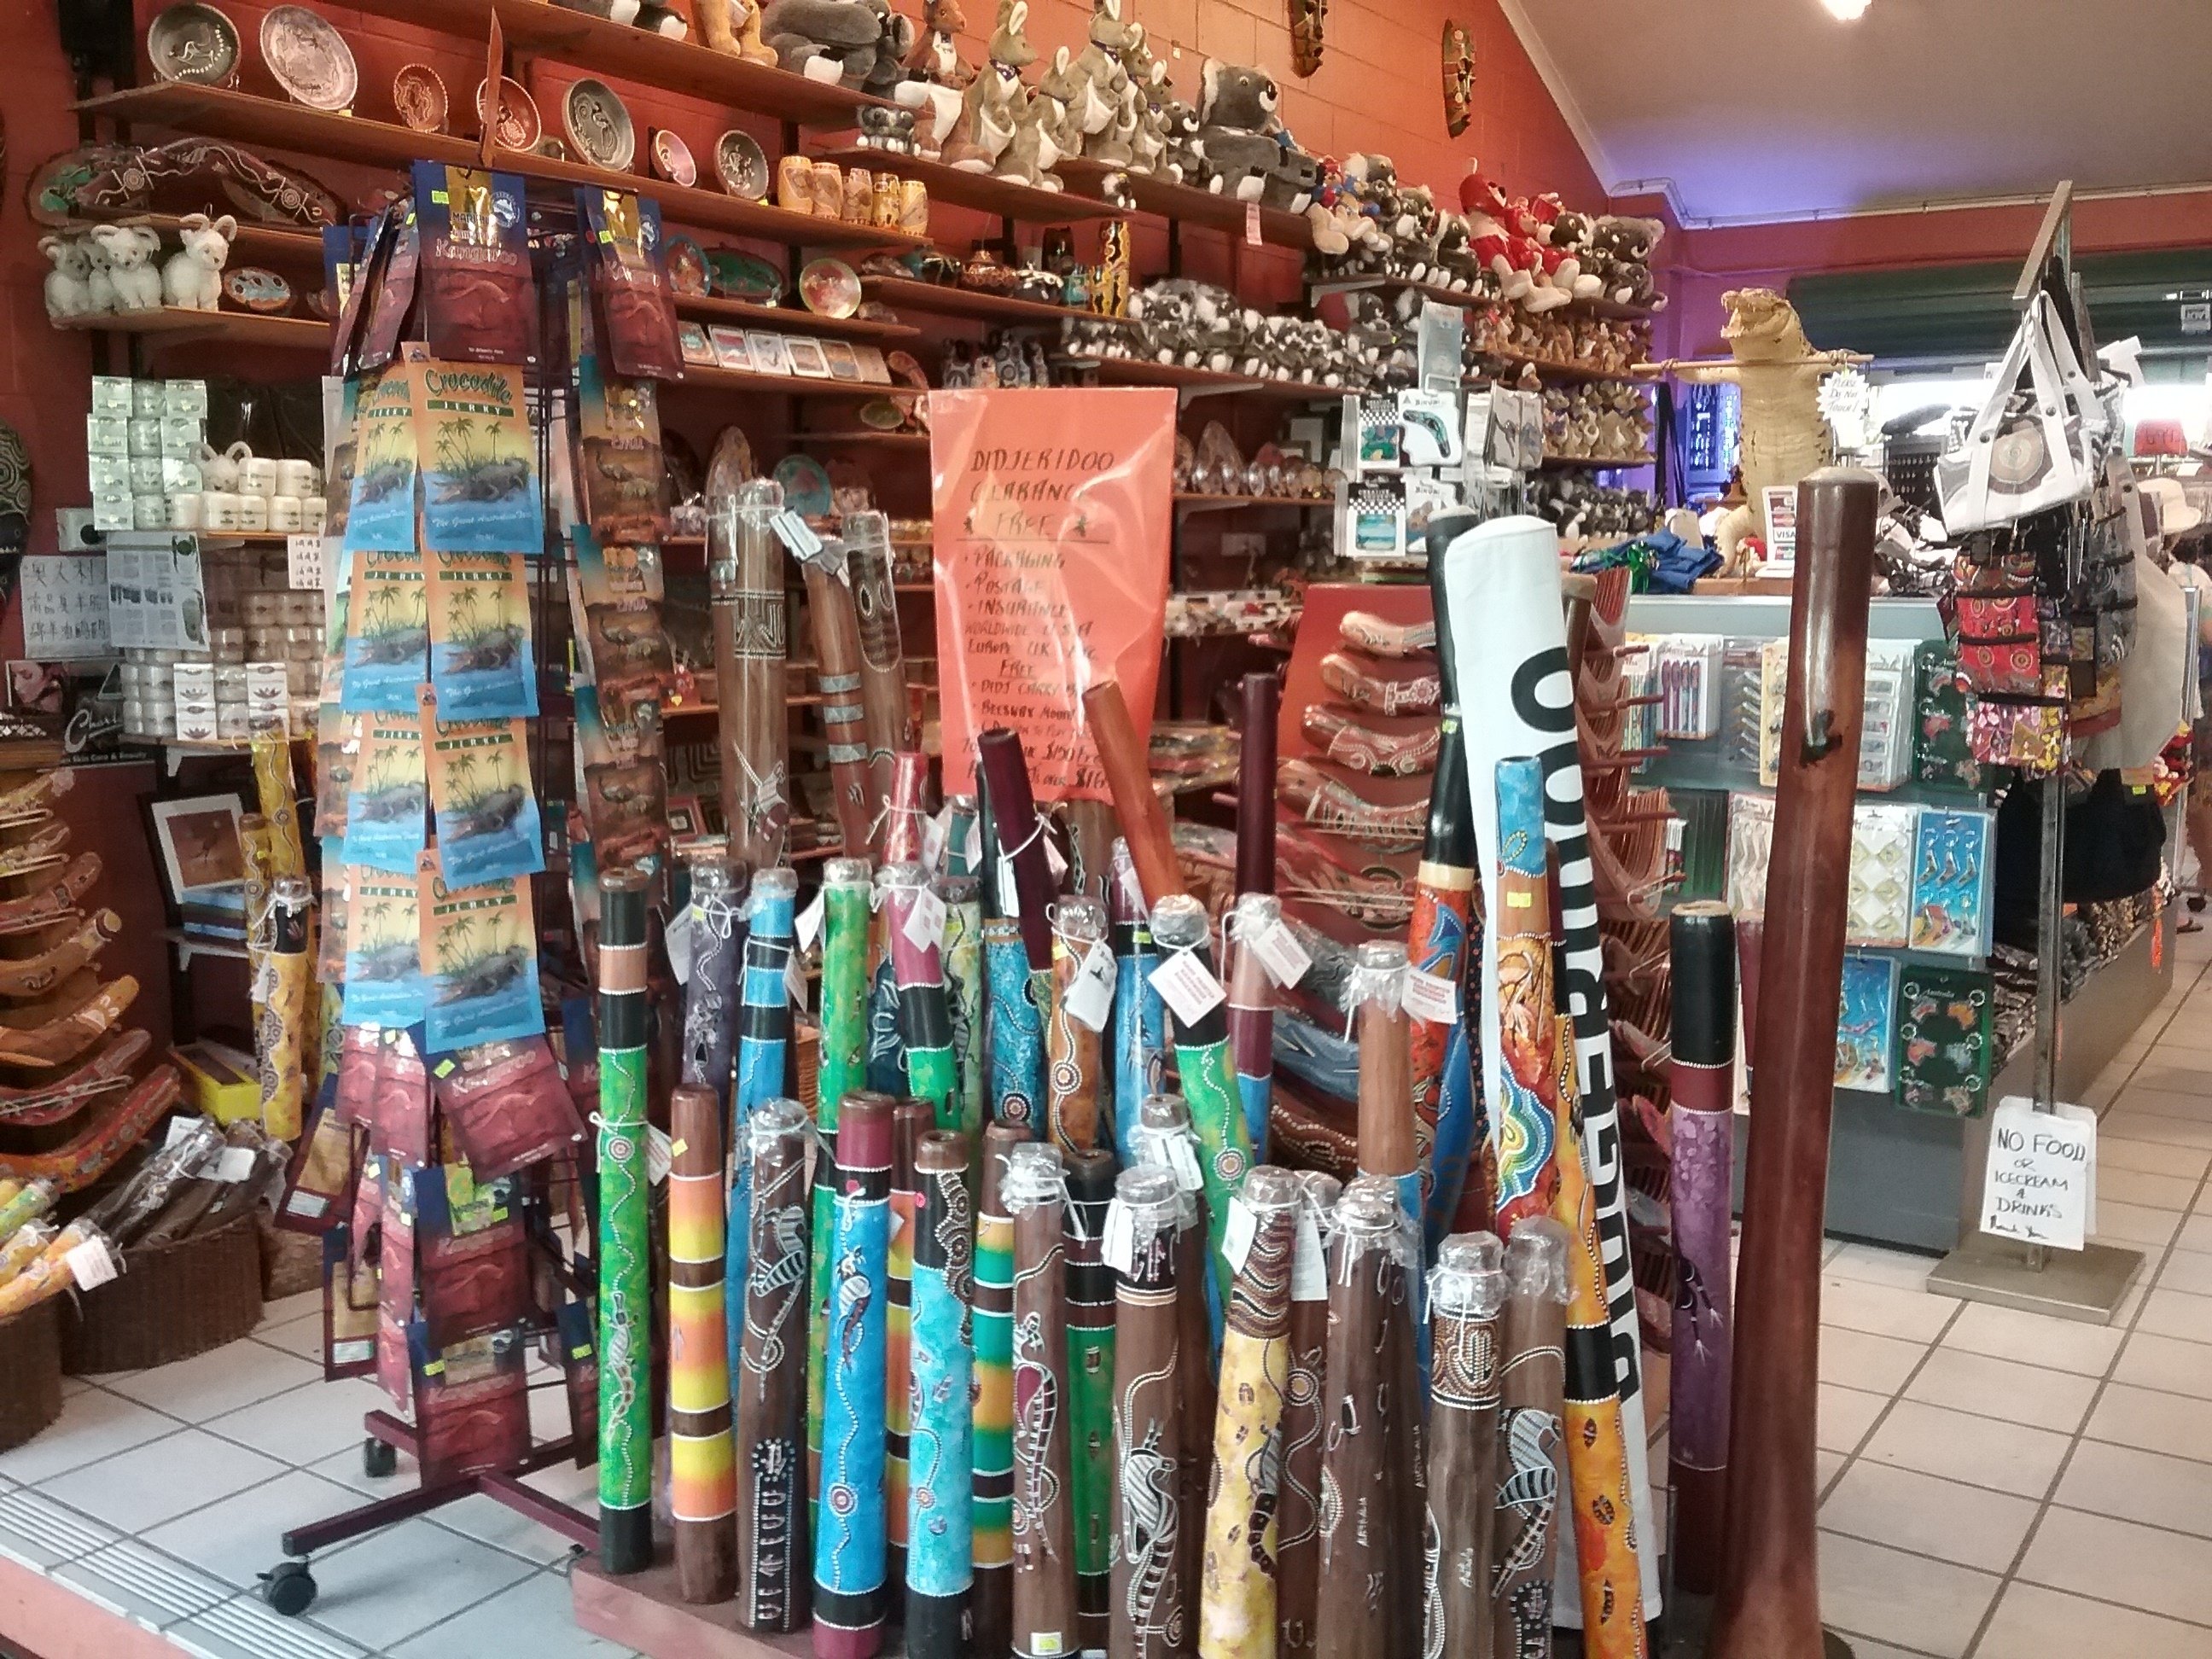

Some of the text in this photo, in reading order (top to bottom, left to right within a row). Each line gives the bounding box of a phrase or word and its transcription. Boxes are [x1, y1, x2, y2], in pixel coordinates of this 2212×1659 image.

[425, 369, 513, 405] Crocodile
[444, 400, 501, 415] JERKY
[970, 448, 1115, 470] DIDJERIDOO
[995, 510, 1055, 537] FREE
[1777, 530, 1796, 539] VISA
[974, 545, 1066, 569] PACKAGING
[452, 573, 504, 581] JERKY
[999, 658, 1036, 679] FREE
[449, 736, 501, 750] JERKY
[445, 899, 503, 914] JERKY
[1997, 1126, 2087, 1161] NO FOOD
[2013, 1157, 2036, 1173] OR
[1994, 1170, 2069, 1191] ICECREAM
[1995, 1196, 2064, 1219] DRINKS
